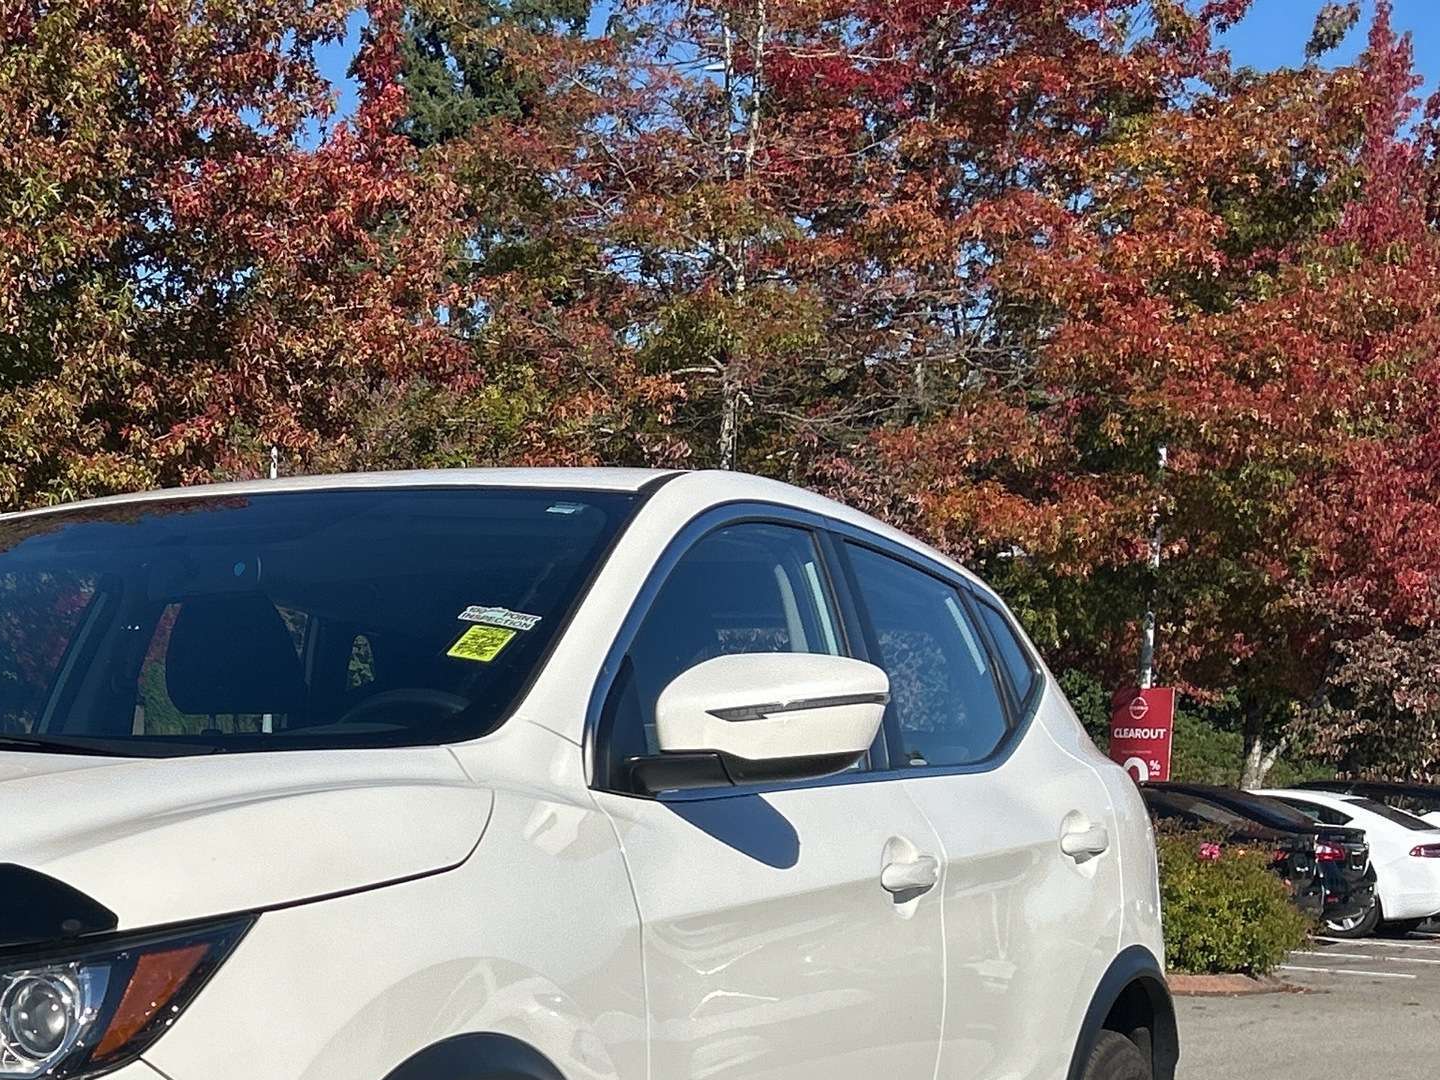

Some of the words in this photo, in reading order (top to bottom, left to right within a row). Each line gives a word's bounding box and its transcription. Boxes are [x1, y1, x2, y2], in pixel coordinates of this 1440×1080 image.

[462, 613, 532, 628] INSPECTION
[504, 611, 537, 622] POINT
[1114, 728, 1166, 739] CLEAROUT
